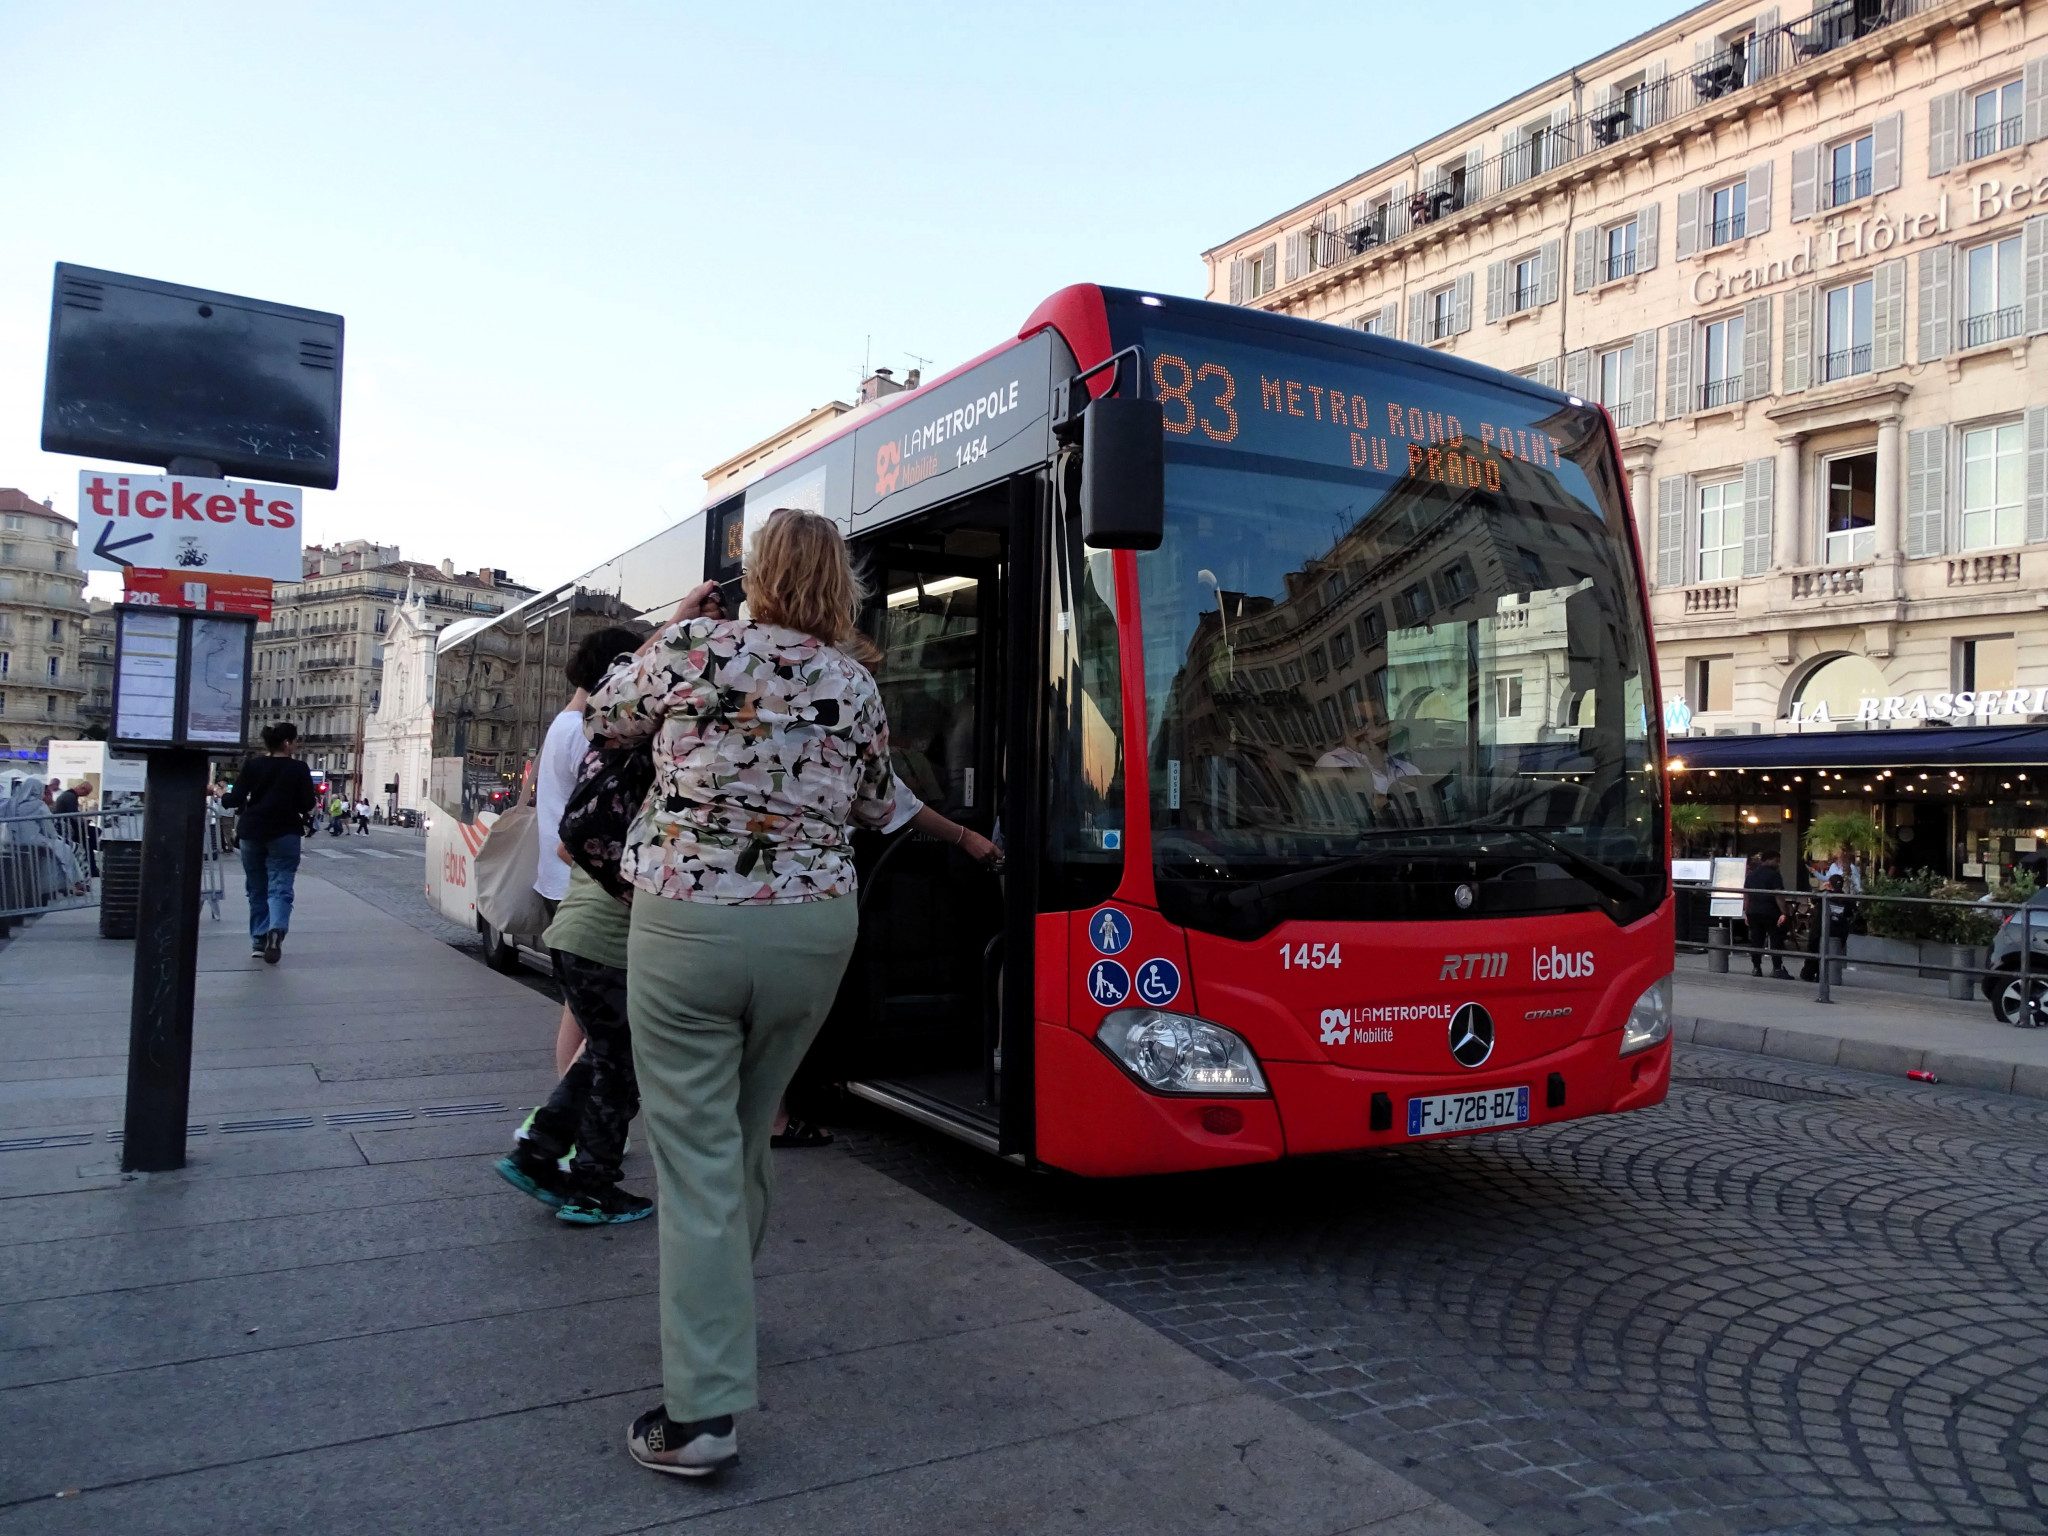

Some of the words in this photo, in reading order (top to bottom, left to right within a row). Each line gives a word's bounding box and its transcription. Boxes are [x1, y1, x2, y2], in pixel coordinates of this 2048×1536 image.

[1689, 235, 1815, 306] Grand
[1826, 193, 1951, 267] Hôtel
[1153, 353, 1240, 442] 83
[1260, 374, 1369, 430] METRO
[1388, 402, 1464, 448] ROND
[1481, 422, 1562, 469] POINT
[903, 453, 938, 485] Mobilité
[956, 435, 988, 469] 1454
[1351, 432, 1388, 471] DU
[1408, 443, 1501, 493] PRADO
[86, 477, 296, 529] tickets
[1789, 700, 1832, 725] LA
[1855, 688, 2048, 722] BRASSERI
[1279, 943, 1342, 970] 1454
[1439, 952, 1509, 981] RTM
[1533, 945, 1595, 981] lebus
[1524, 1007, 1573, 1021] CITARO
[1353, 1026, 1394, 1044] Mobilité
[1421, 1091, 1515, 1128] FJ-726-BZ
[1518, 1105, 1528, 1118] 13
